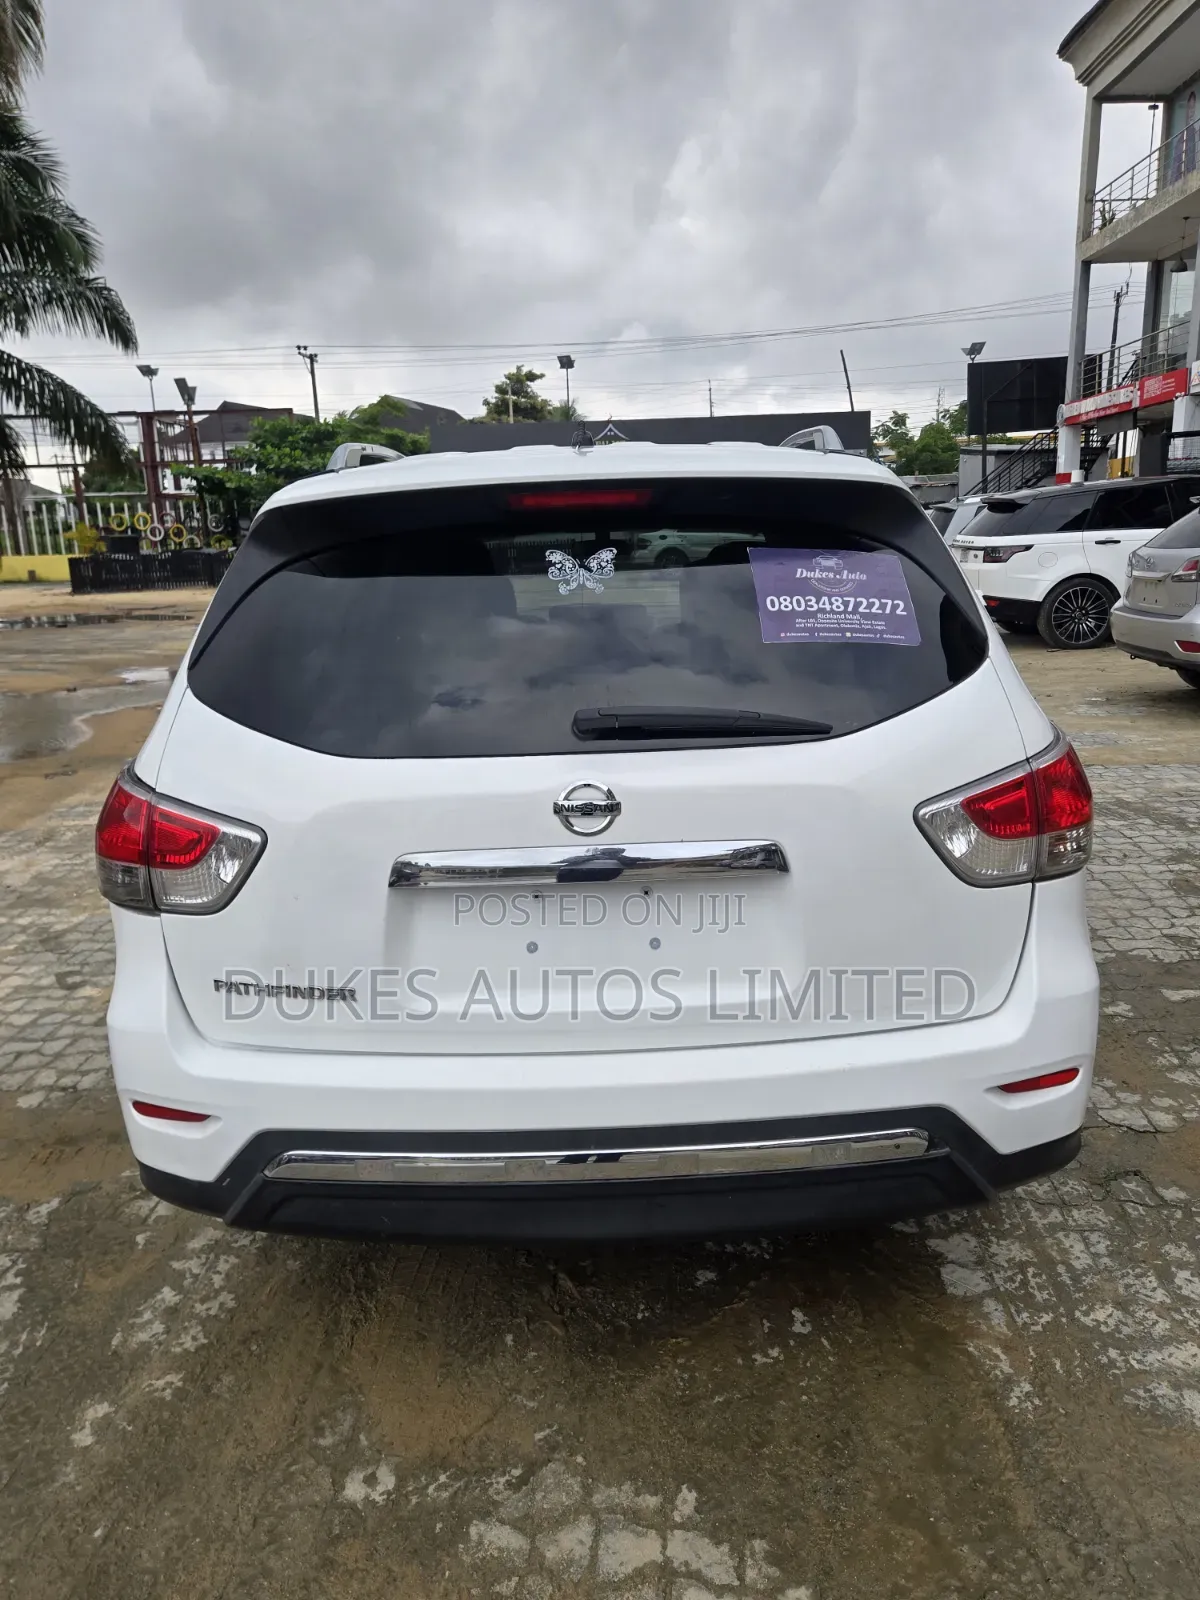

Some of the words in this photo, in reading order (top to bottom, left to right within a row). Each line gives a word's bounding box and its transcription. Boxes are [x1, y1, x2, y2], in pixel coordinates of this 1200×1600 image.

[795, 568, 834, 578] Dukes
[836, 570, 867, 580] Auto
[766, 596, 907, 615] 08034872272
[560, 803, 614, 813] NISSAN
[213, 979, 358, 1002] PATHFINDER
